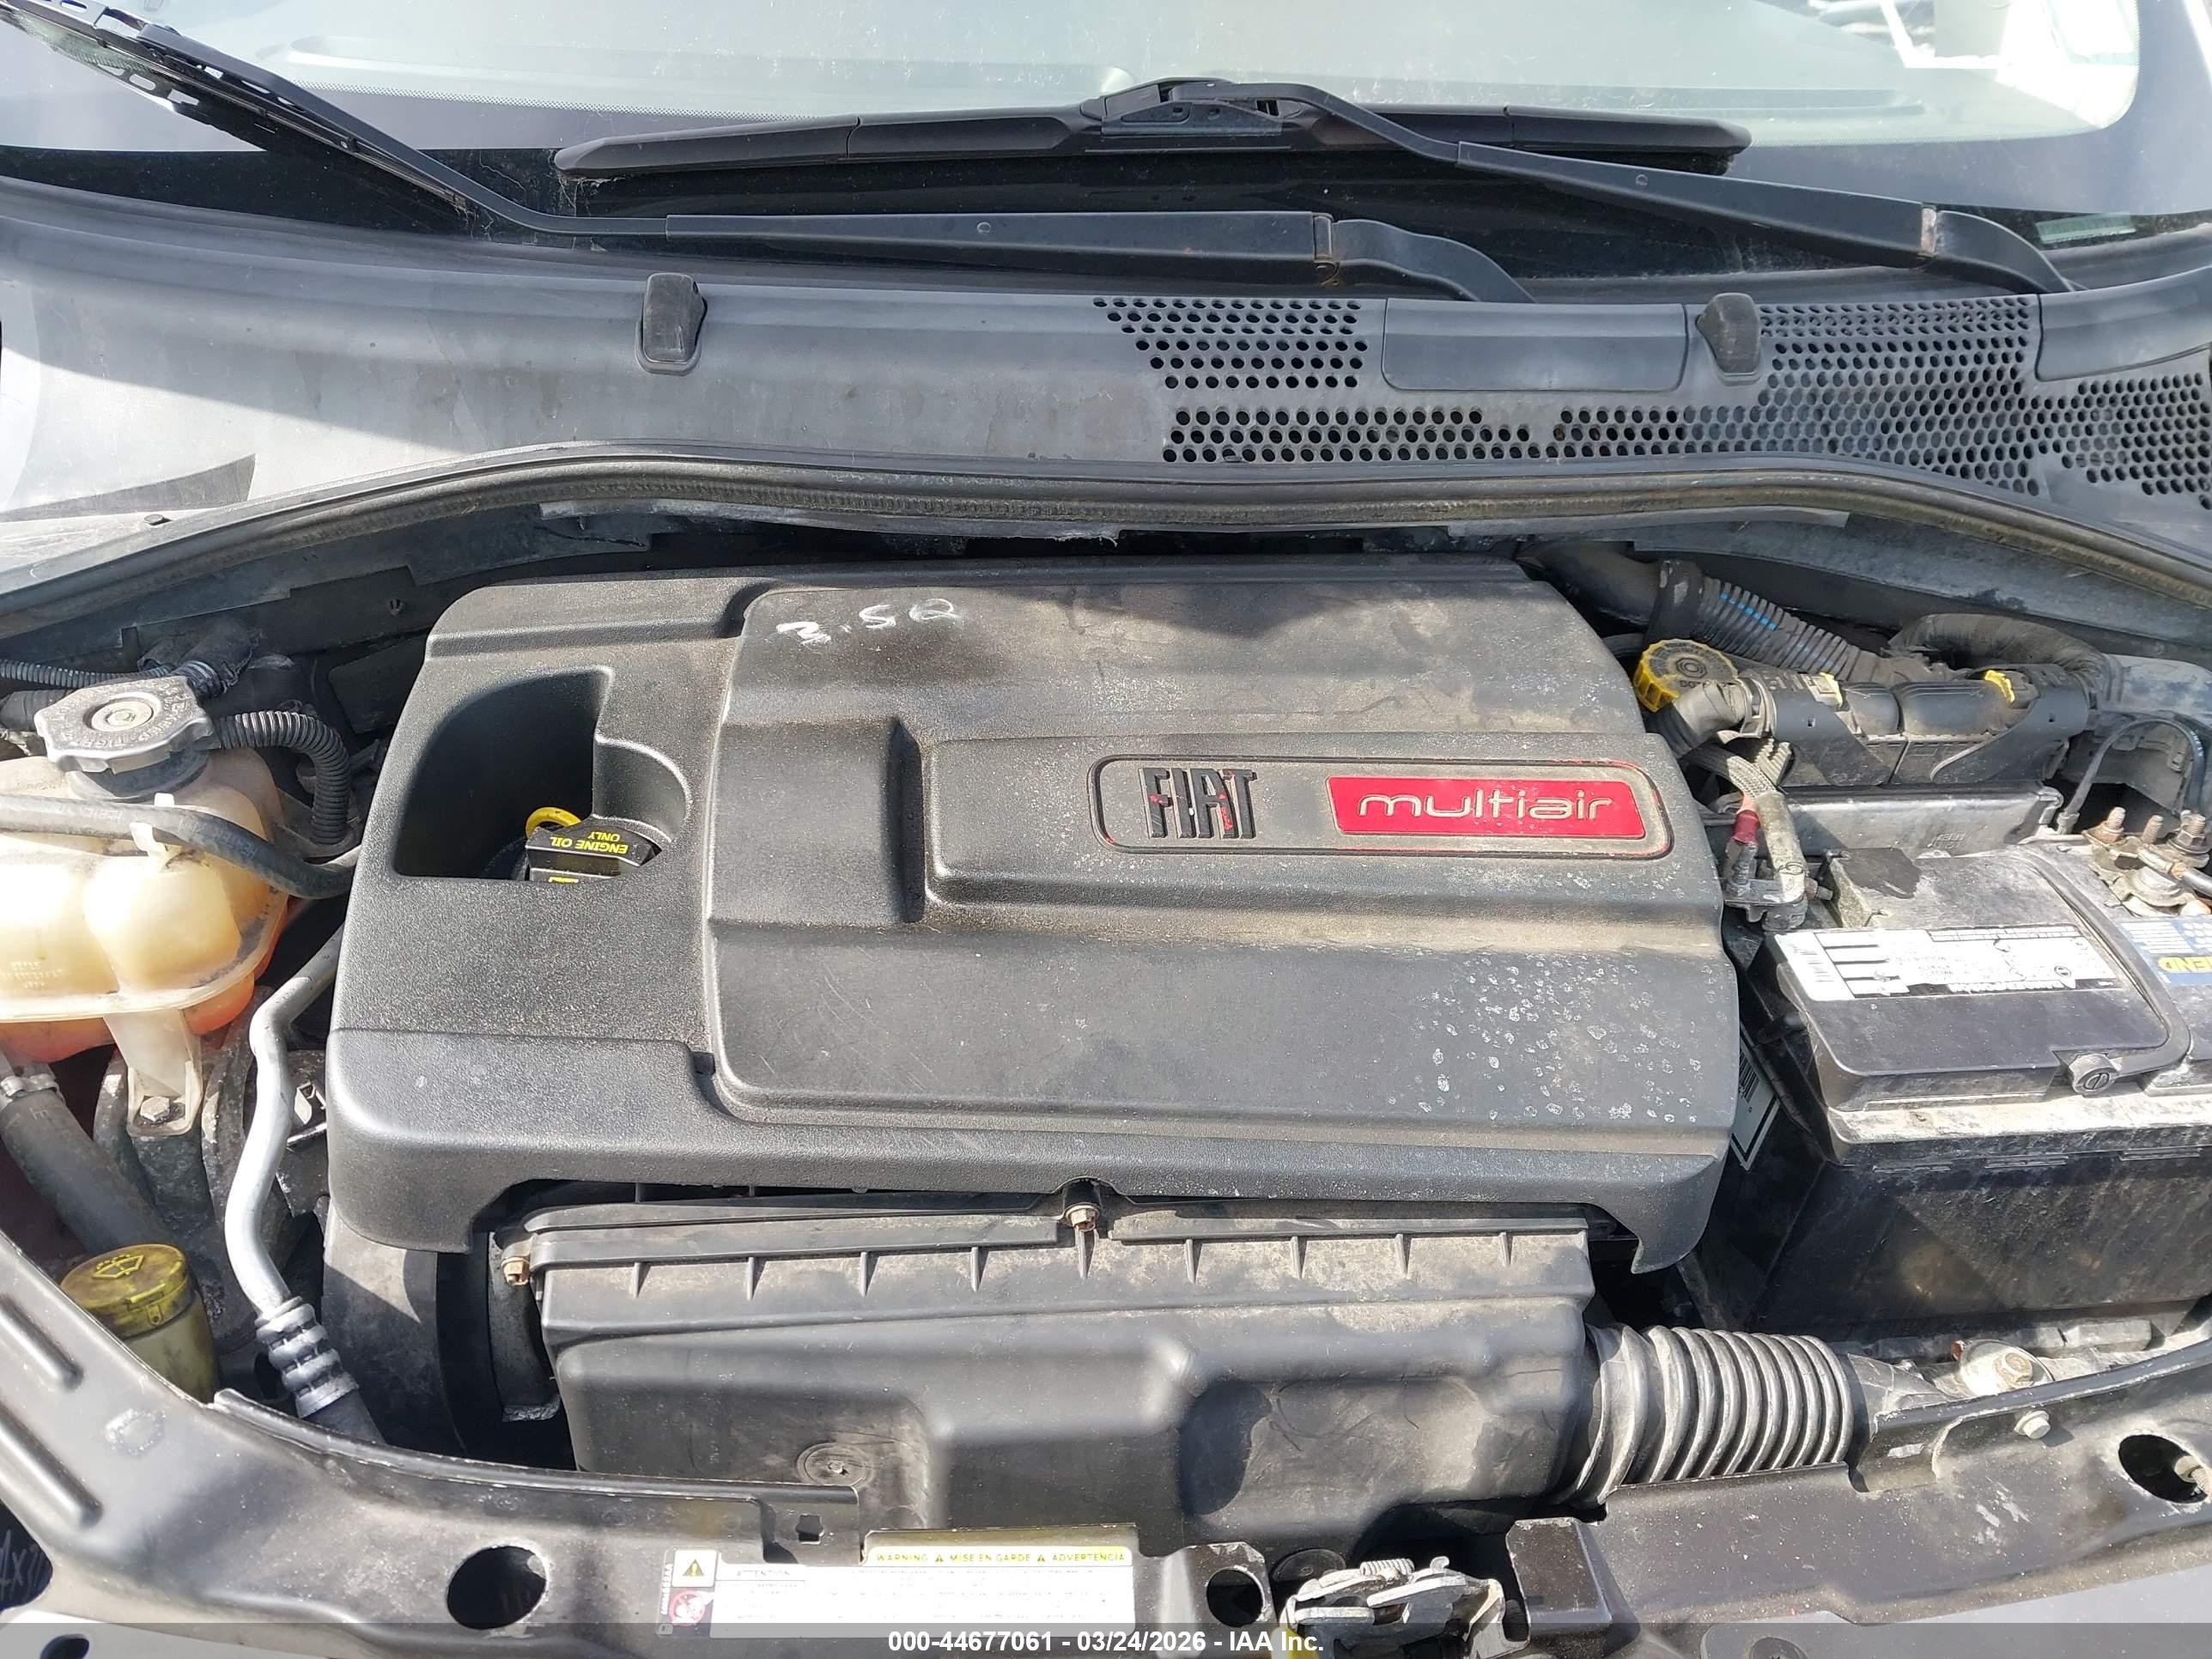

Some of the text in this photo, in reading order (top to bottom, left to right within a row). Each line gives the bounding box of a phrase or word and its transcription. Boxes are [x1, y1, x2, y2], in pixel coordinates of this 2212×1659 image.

[1138, 767, 1257, 839] FIAT
[1358, 787, 1613, 821] multiair
[550, 836, 629, 854] ENGINE OIL
[587, 831, 621, 842] ONLY
[877, 1553, 1125, 1562] WARNING MISE EN GARDE ADVERTENCIA
